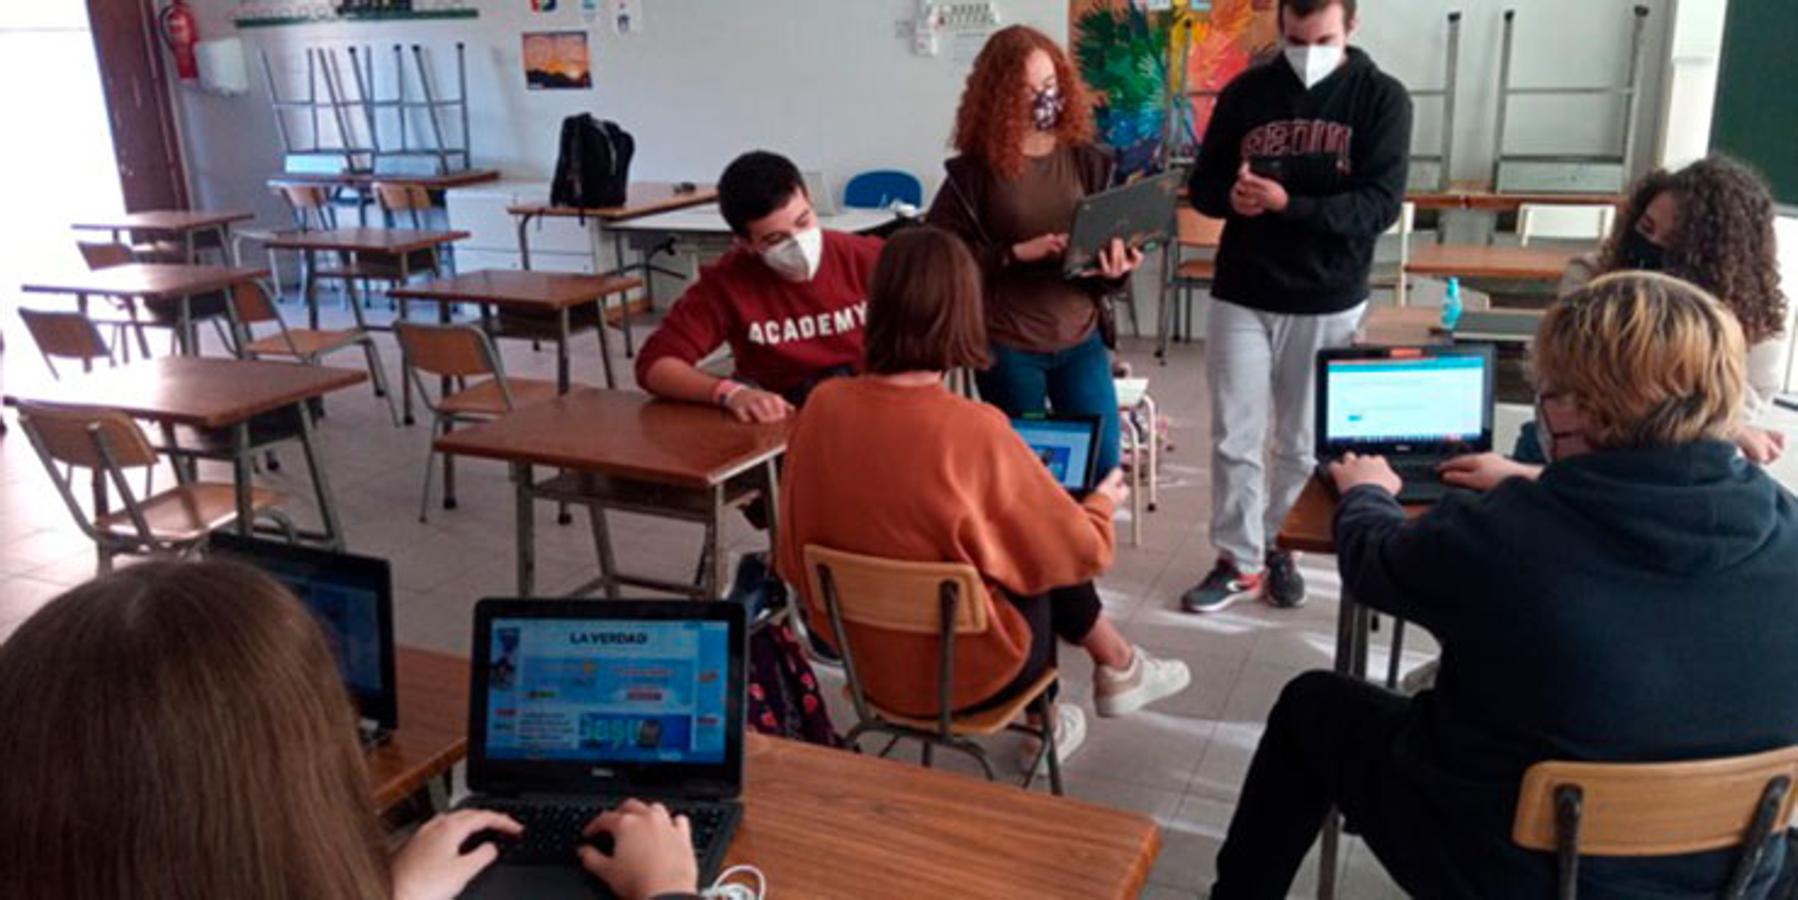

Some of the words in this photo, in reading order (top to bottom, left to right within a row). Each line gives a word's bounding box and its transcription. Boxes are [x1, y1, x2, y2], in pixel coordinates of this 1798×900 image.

[748, 300, 868, 345] ACADEMY
[569, 631, 588, 645] LA
[590, 631, 648, 645] VERDAD
